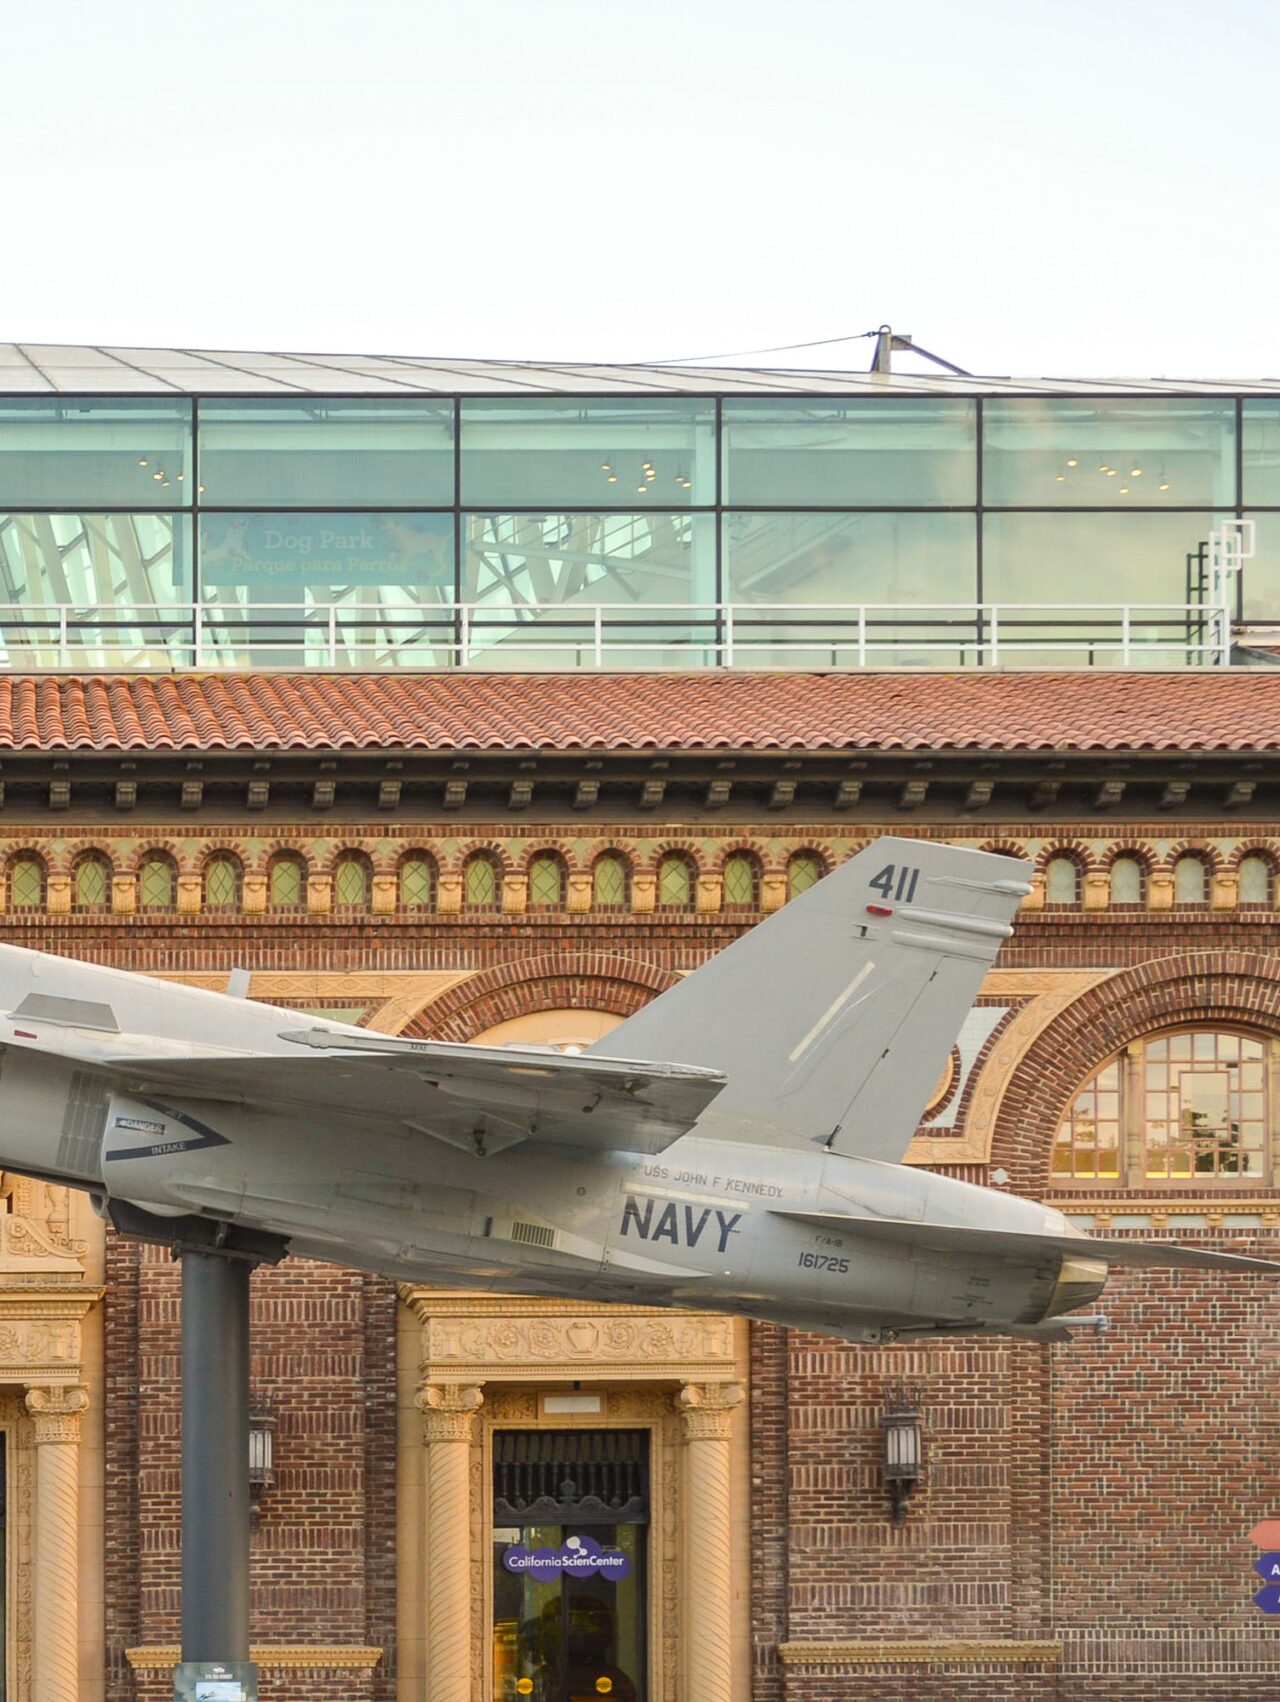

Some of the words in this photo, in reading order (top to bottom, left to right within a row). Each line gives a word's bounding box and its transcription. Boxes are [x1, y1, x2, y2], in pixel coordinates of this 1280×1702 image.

[264, 530, 313, 553] Dog
[319, 529, 376, 550] Park
[231, 558, 296, 576] Parque
[300, 560, 342, 576] para
[868, 863, 920, 903] 411
[127, 1120, 163, 1134] DANGER
[151, 1141, 187, 1155] INTAKE
[643, 1164, 669, 1180] USS
[674, 1170, 708, 1187] JOHN
[712, 1176, 722, 1188] F
[725, 1178, 784, 1198] KENNEDY
[620, 1195, 743, 1253] NAVY
[798, 1252, 851, 1274] 161725
